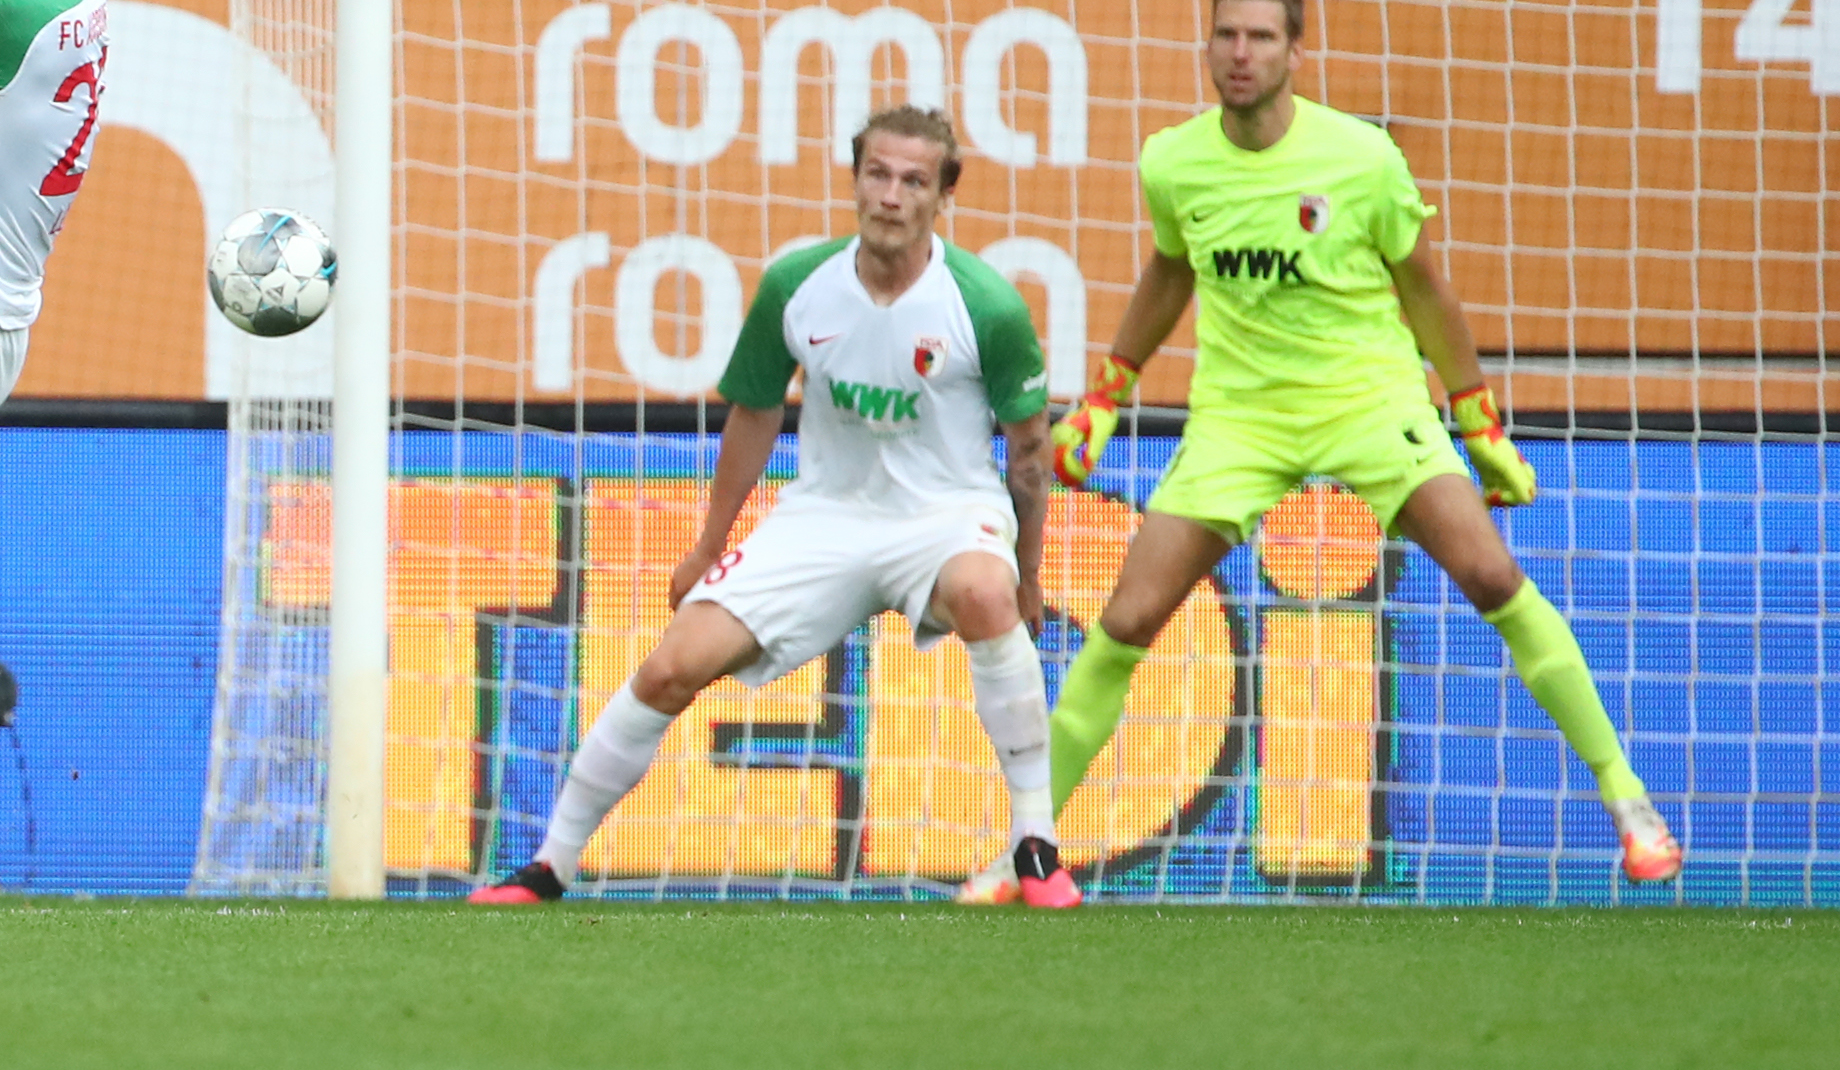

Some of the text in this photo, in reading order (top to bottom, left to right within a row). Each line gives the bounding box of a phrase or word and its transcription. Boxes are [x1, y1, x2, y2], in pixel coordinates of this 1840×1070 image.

[58, 19, 84, 51] FC
[533, 2, 1089, 168] roma
[1212, 247, 1308, 285] WWK
[829, 378, 920, 422] WWK
